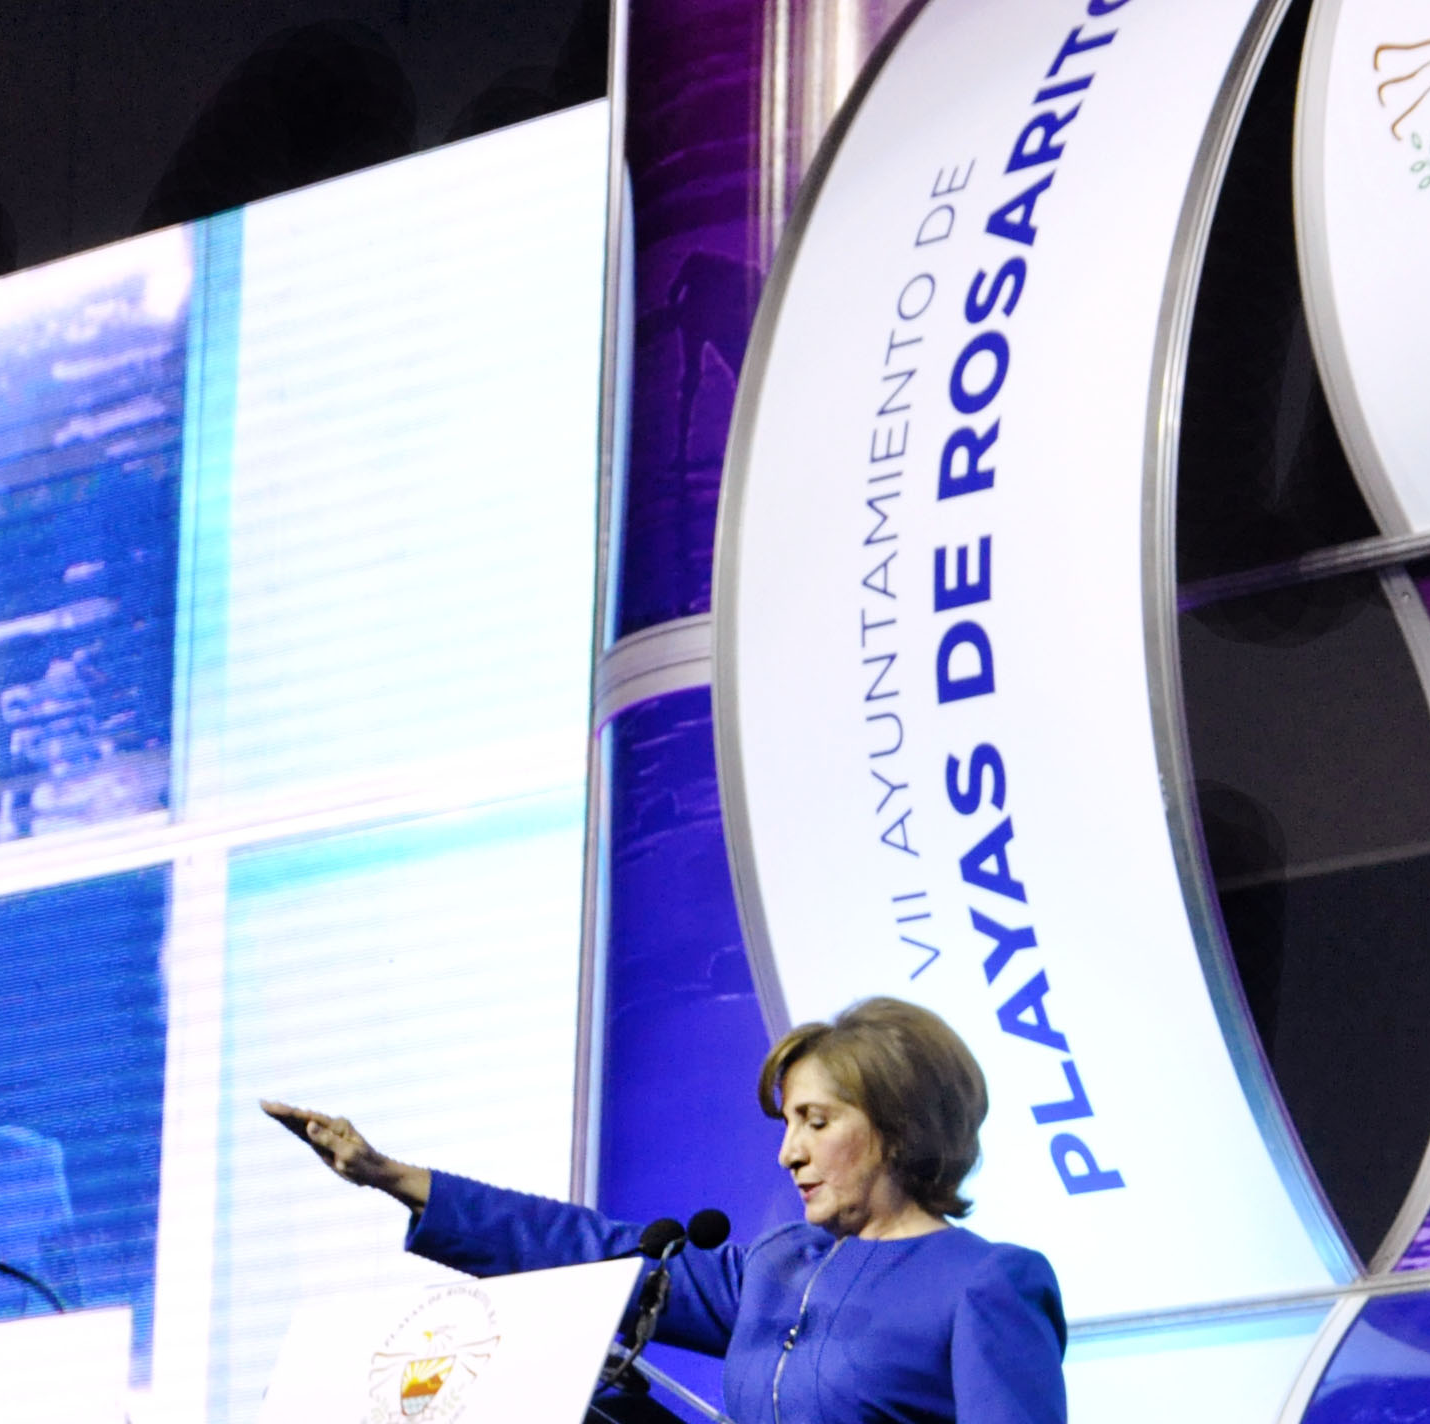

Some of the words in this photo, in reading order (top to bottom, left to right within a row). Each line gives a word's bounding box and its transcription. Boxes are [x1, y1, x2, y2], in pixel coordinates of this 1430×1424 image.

[915, 157, 977, 248] DE
[937, 0, 1132, 502] ROSARIT
[860, 272, 936, 857] AYUNTAMIENTO
[934, 534, 997, 705] DE
[893, 890, 941, 980] VII
[945, 742, 1127, 1196] PLAYAS
